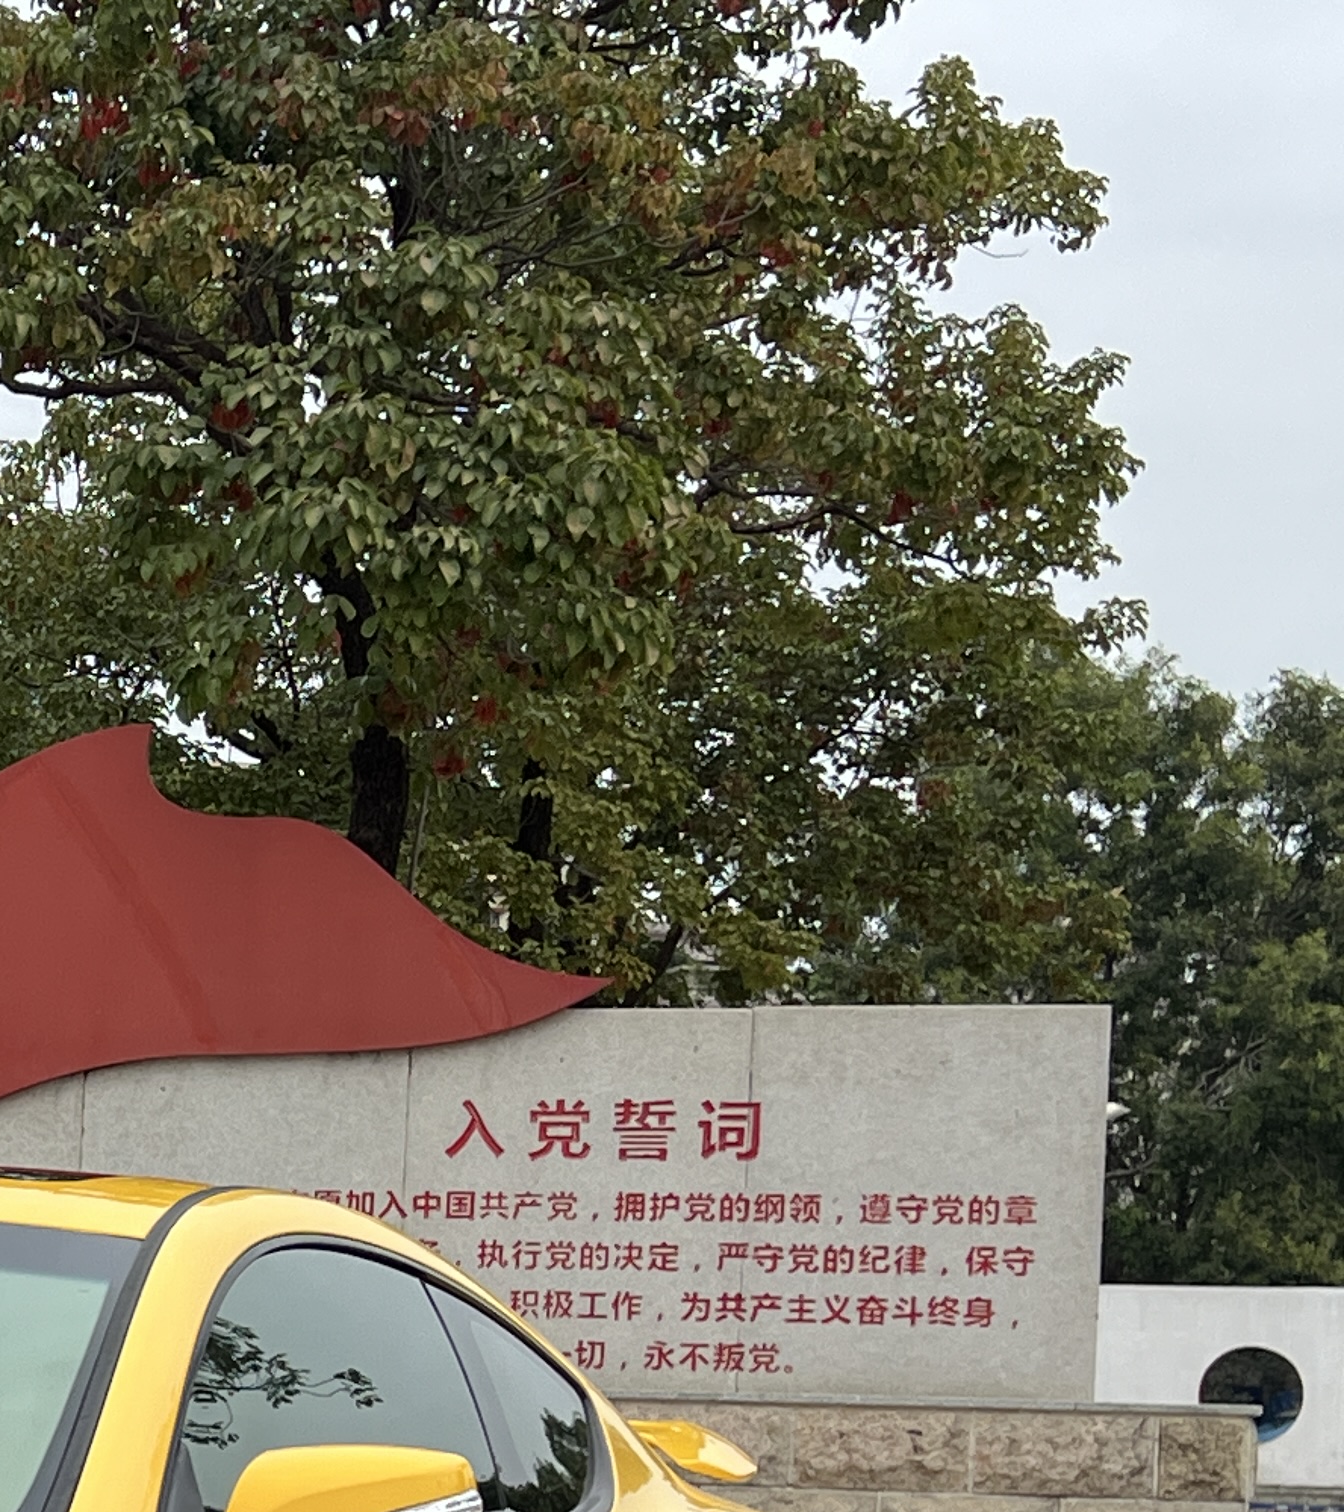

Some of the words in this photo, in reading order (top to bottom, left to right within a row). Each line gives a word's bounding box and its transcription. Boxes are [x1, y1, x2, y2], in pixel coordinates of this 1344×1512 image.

[444, 1097, 763, 1163] 入党誓词
[510, 1288, 1021, 1330] 积极工作，为共产主义奋斗终身，
